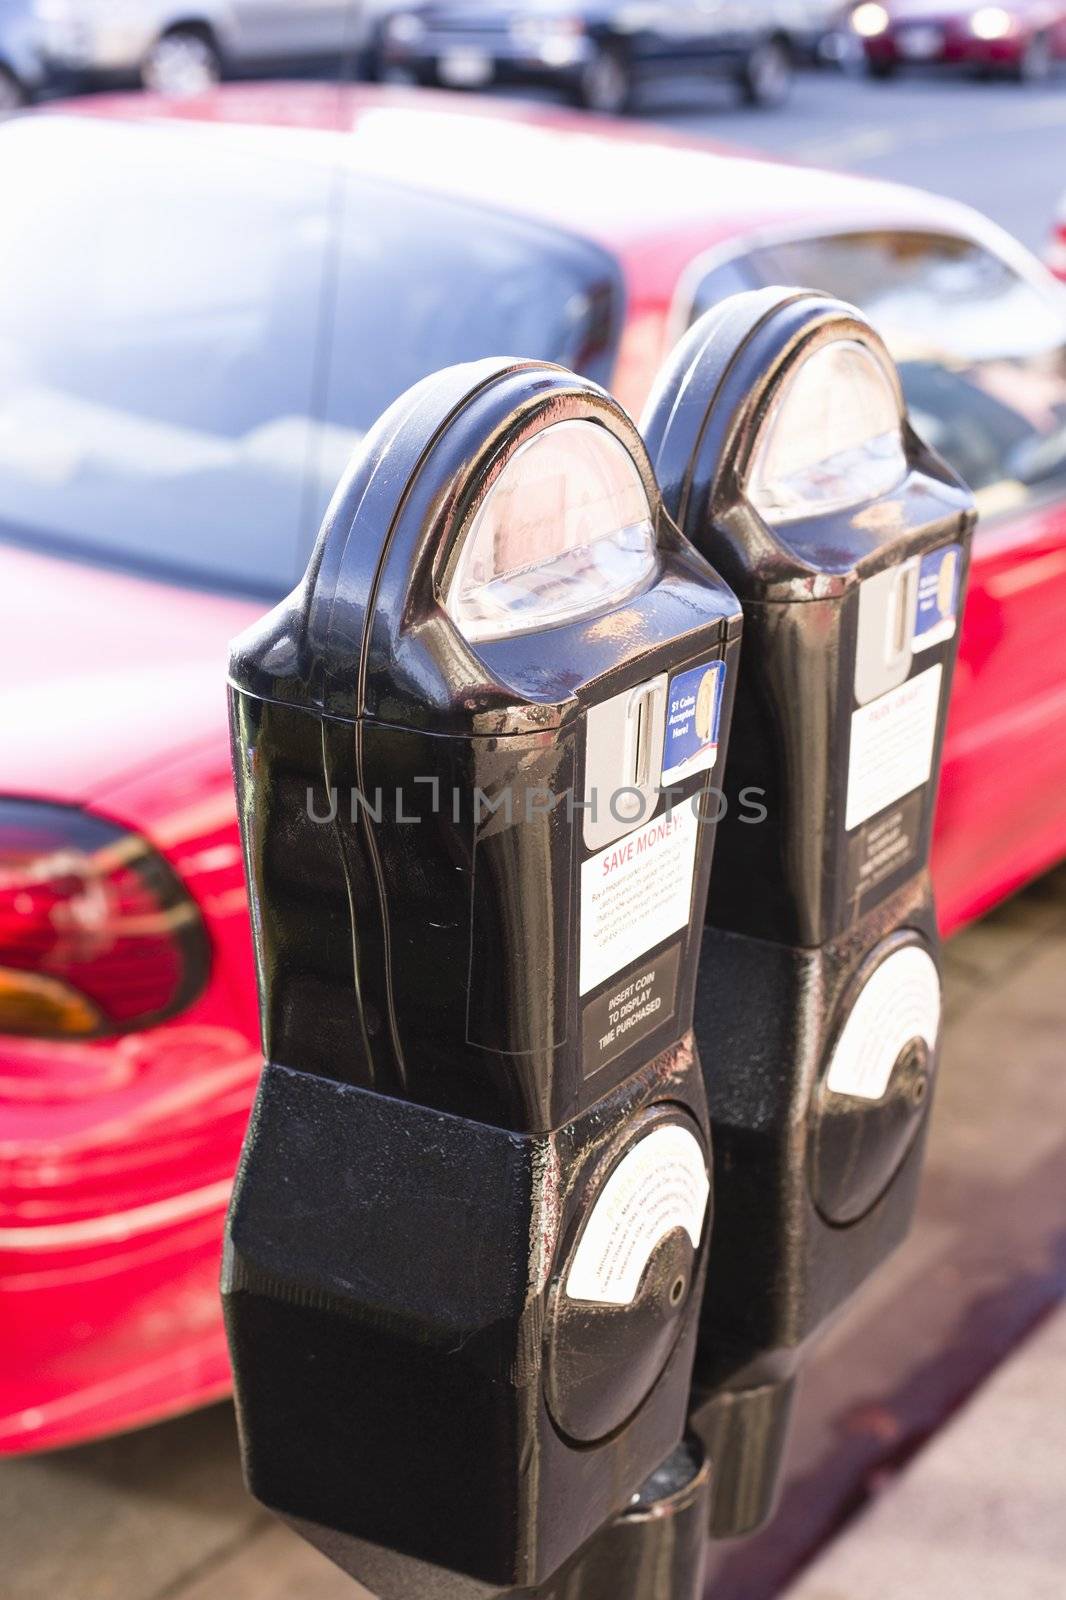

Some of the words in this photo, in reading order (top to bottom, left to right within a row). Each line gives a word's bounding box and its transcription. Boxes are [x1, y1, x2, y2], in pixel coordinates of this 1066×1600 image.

[668, 704, 696, 725] Accepted
[603, 841, 634, 876] SAVE
[608, 984, 635, 1011] INSERT
[635, 971, 656, 991] COIN
[608, 1011, 619, 1025] TO
[619, 987, 652, 1018] DISPLAY
[598, 1029, 616, 1050] TIME
[616, 997, 662, 1037] PURCHASED
